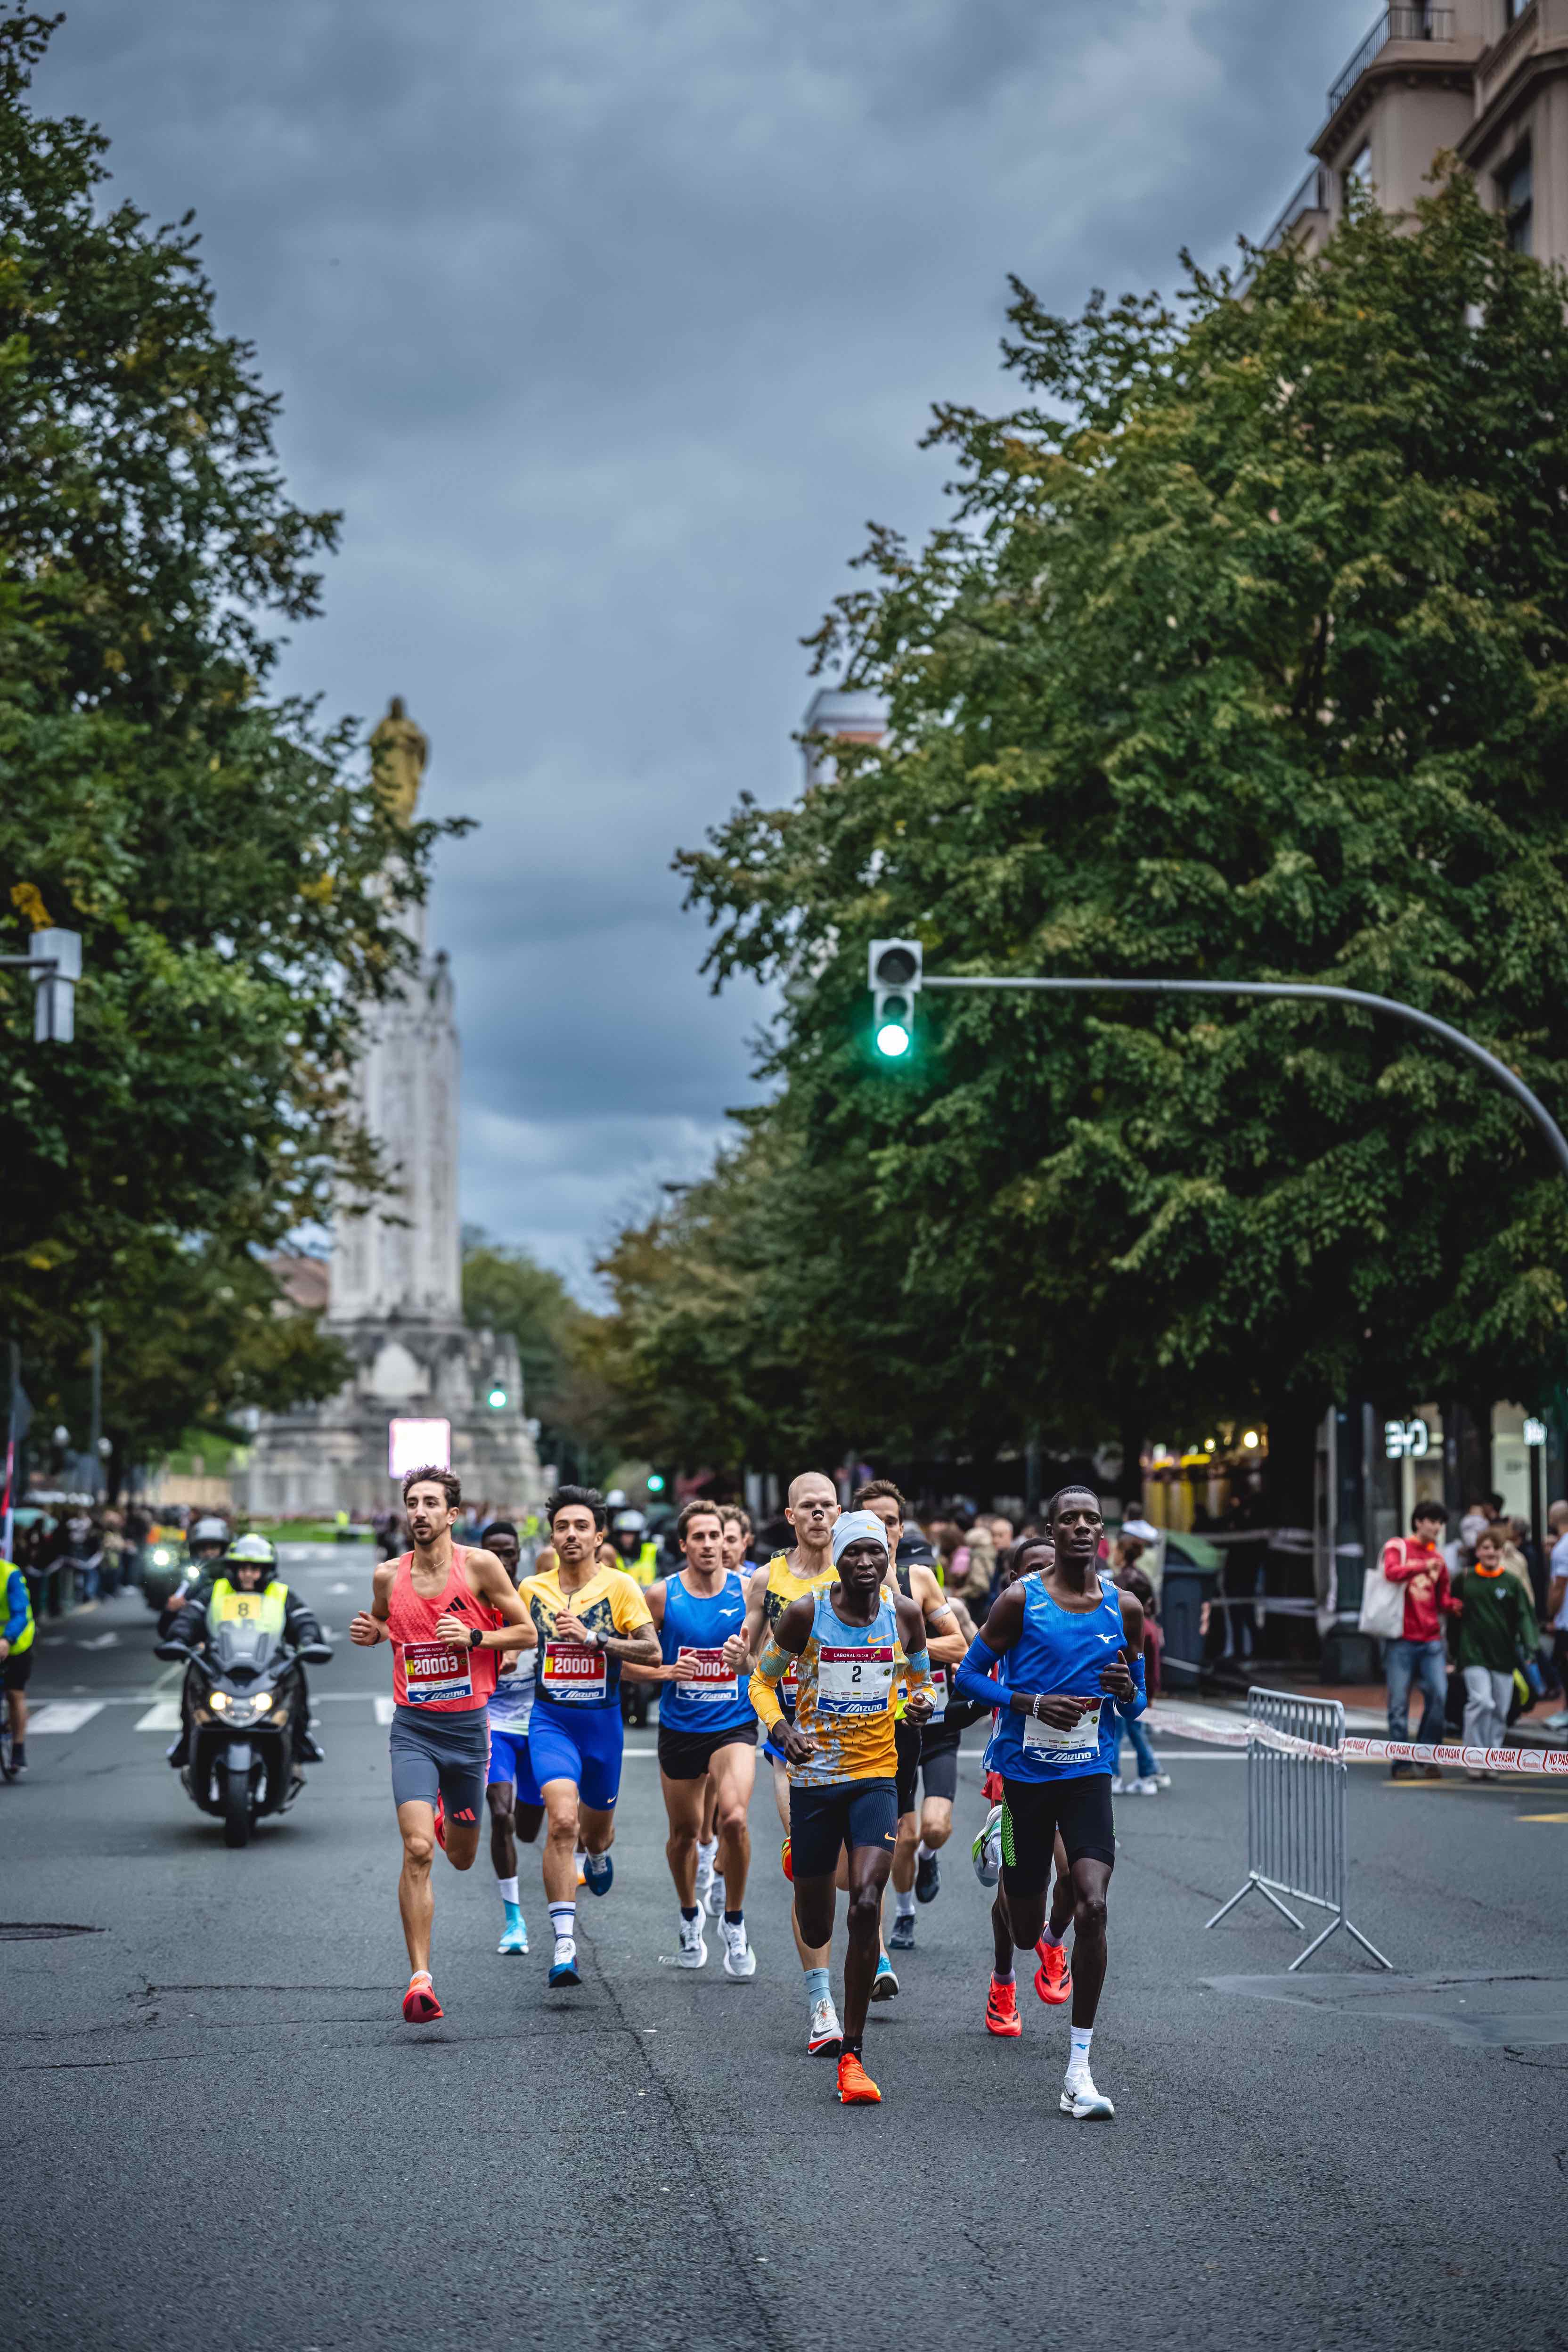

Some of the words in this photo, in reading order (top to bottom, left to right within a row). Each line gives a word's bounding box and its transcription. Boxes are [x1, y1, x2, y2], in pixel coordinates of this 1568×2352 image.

[238, 1603, 248, 1616] 8
[414, 1656, 459, 1675] 20003
[554, 1658, 595, 1674] 20001
[695, 1662, 730, 1676] 0004
[852, 1665, 862, 1682] 2
[1353, 1741, 1366, 1750] PASAR
[1390, 1745, 1396, 1754] NO
[1396, 1745, 1410, 1755] PASAR
[1437, 1748, 1444, 1757] NO
[1445, 1748, 1460, 1759] PASAR
[1490, 1750, 1498, 1761] NO
[1498, 1751, 1515, 1763] PASAR
[1549, 1753, 1557, 1764] NO
[1558, 1754, 1568, 1766] PAS
